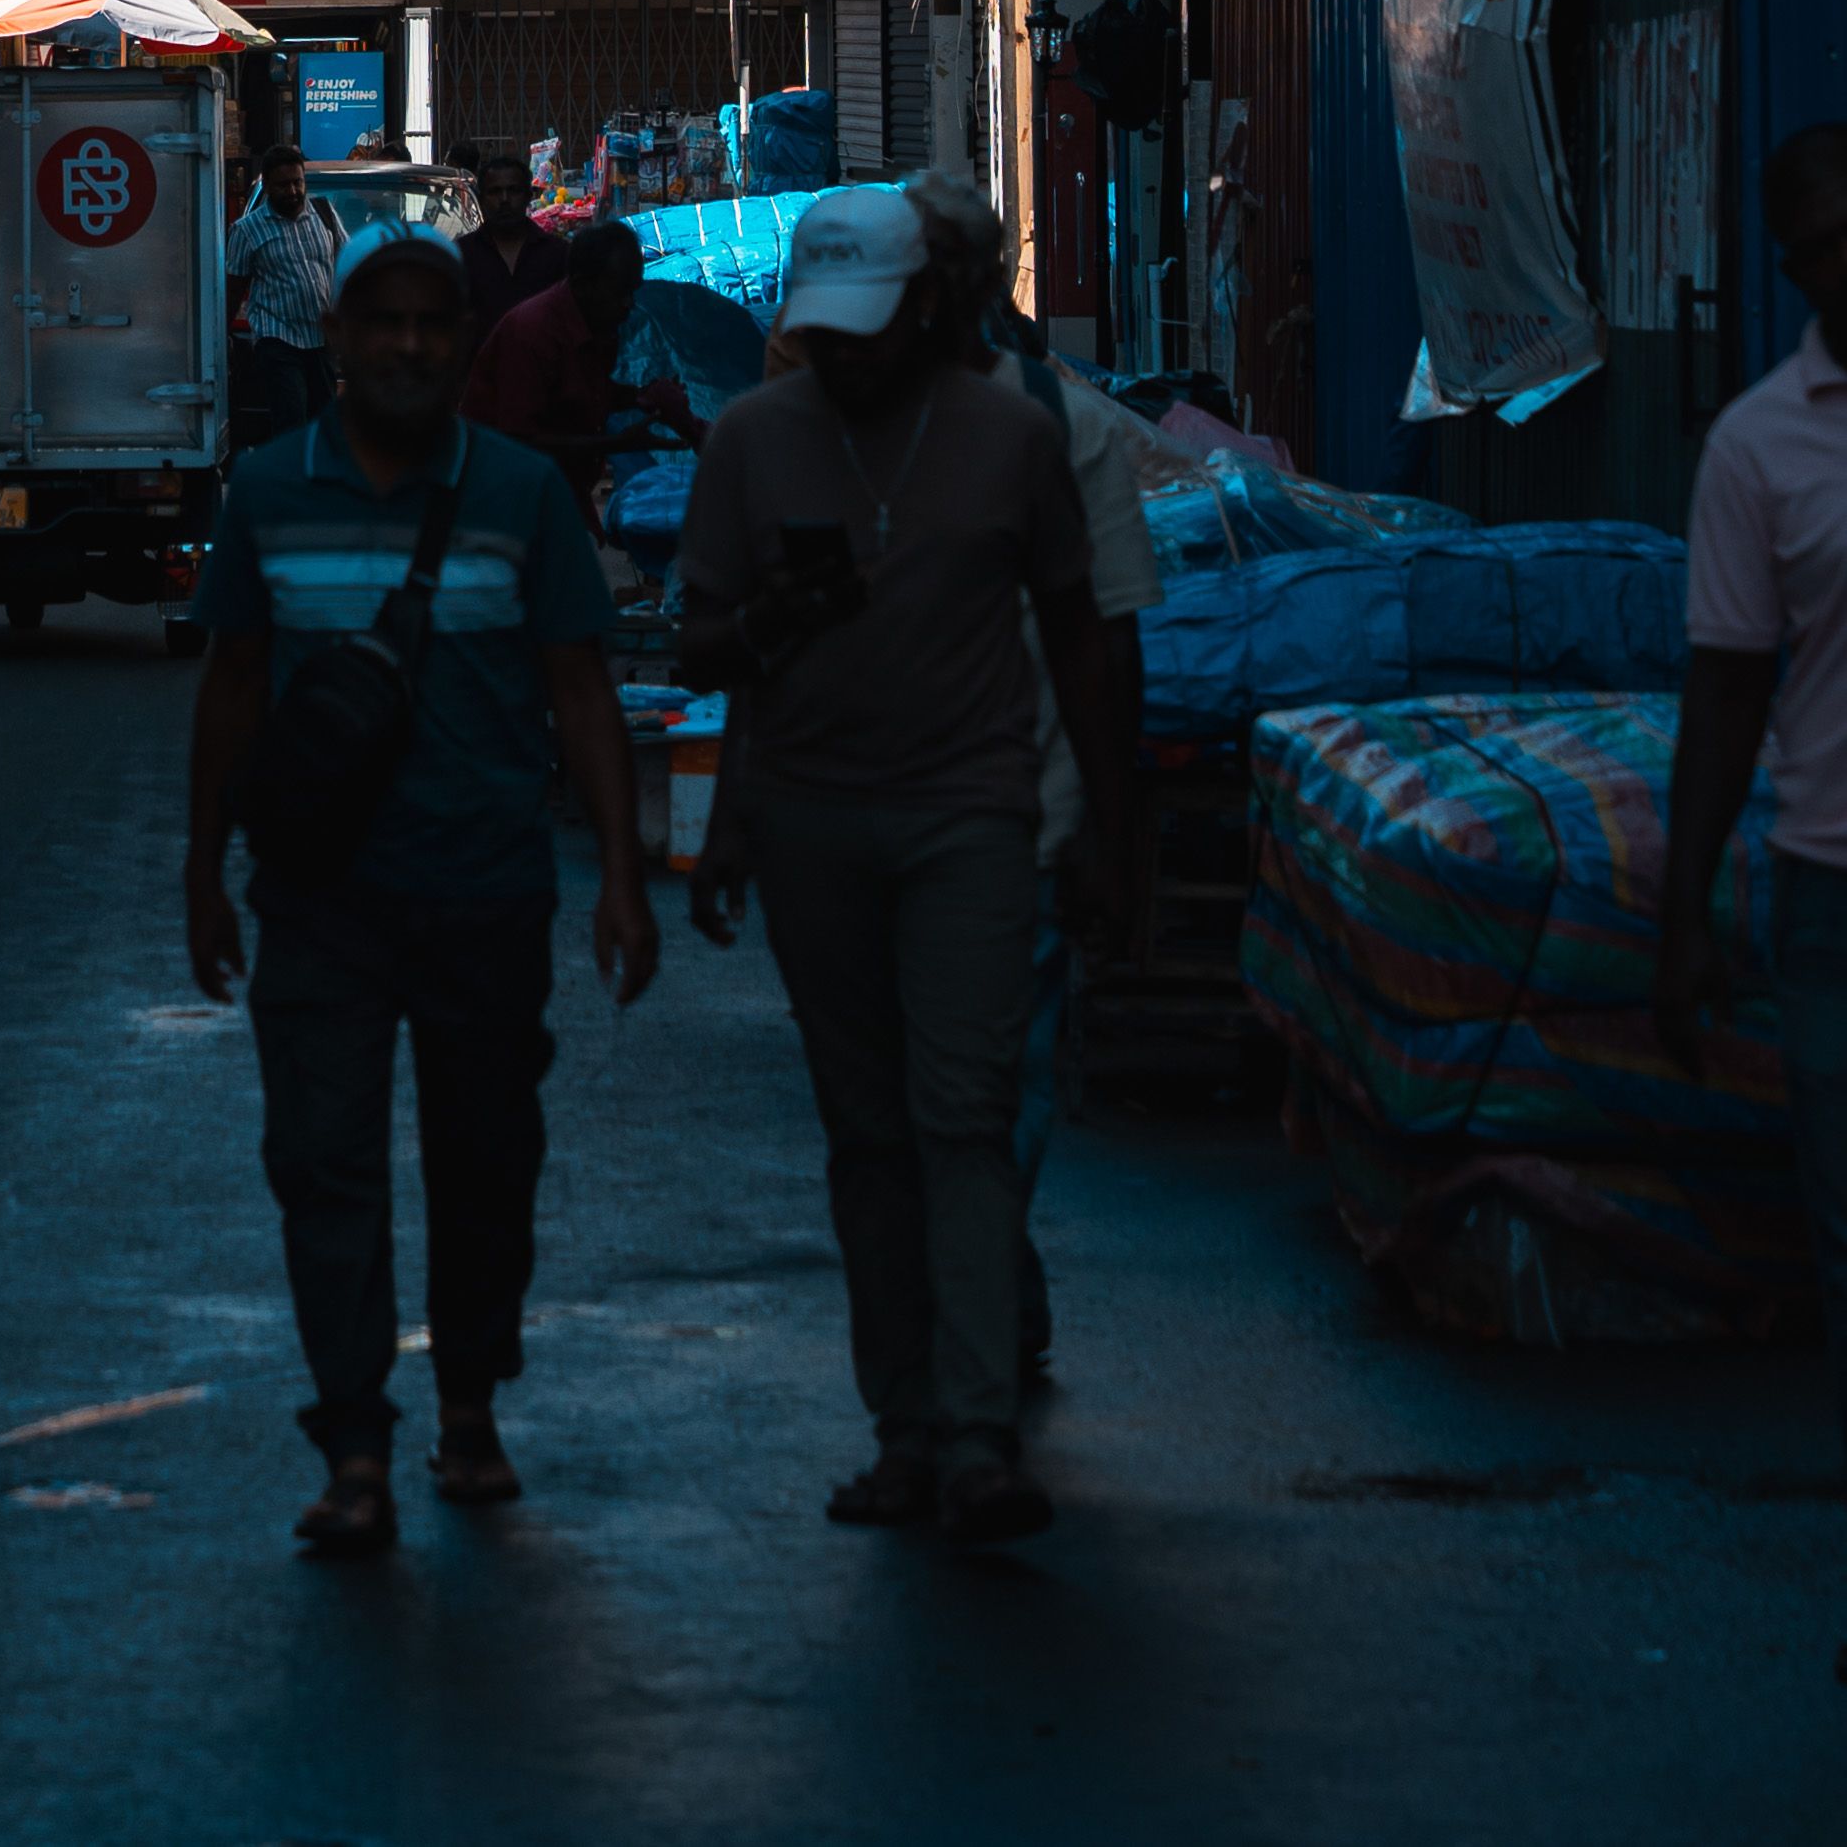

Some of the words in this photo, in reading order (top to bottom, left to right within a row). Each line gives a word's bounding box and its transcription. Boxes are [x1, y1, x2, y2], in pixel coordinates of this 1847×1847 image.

[317, 78, 356, 90] ENJOY
[305, 90, 378, 101] REFRESHING
[305, 102, 339, 113] PEPSI
